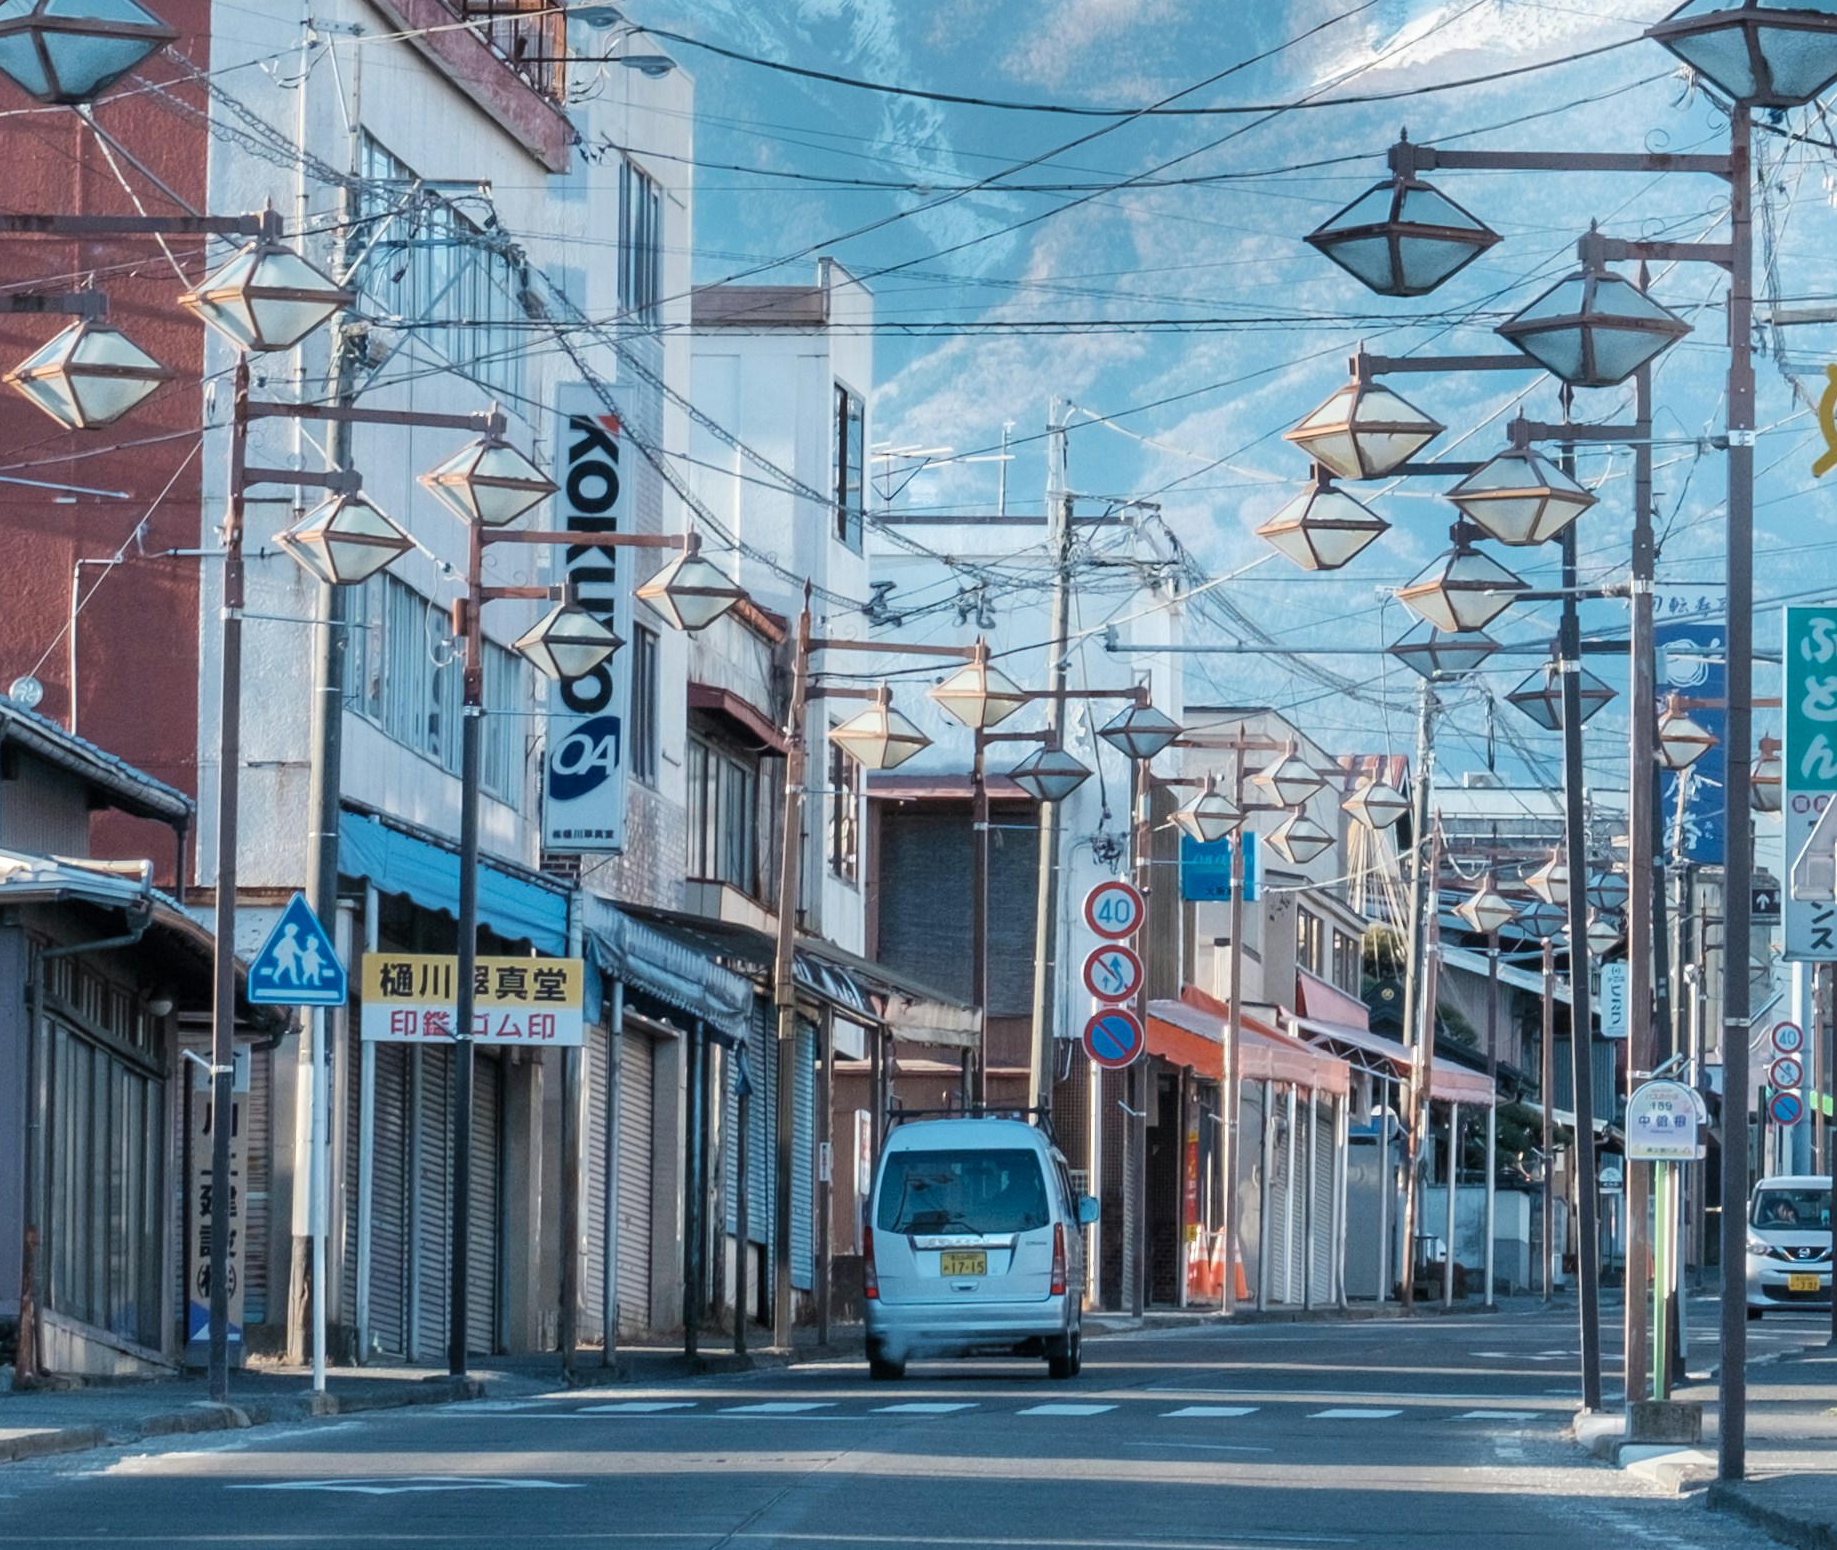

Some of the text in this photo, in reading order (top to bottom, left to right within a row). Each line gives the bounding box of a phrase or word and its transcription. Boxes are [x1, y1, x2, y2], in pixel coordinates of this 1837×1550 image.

[559, 413, 619, 714] KOKUO
[550, 732, 617, 778] OA
[1098, 897, 1130, 924] 40
[1778, 1031, 1797, 1045] 40
